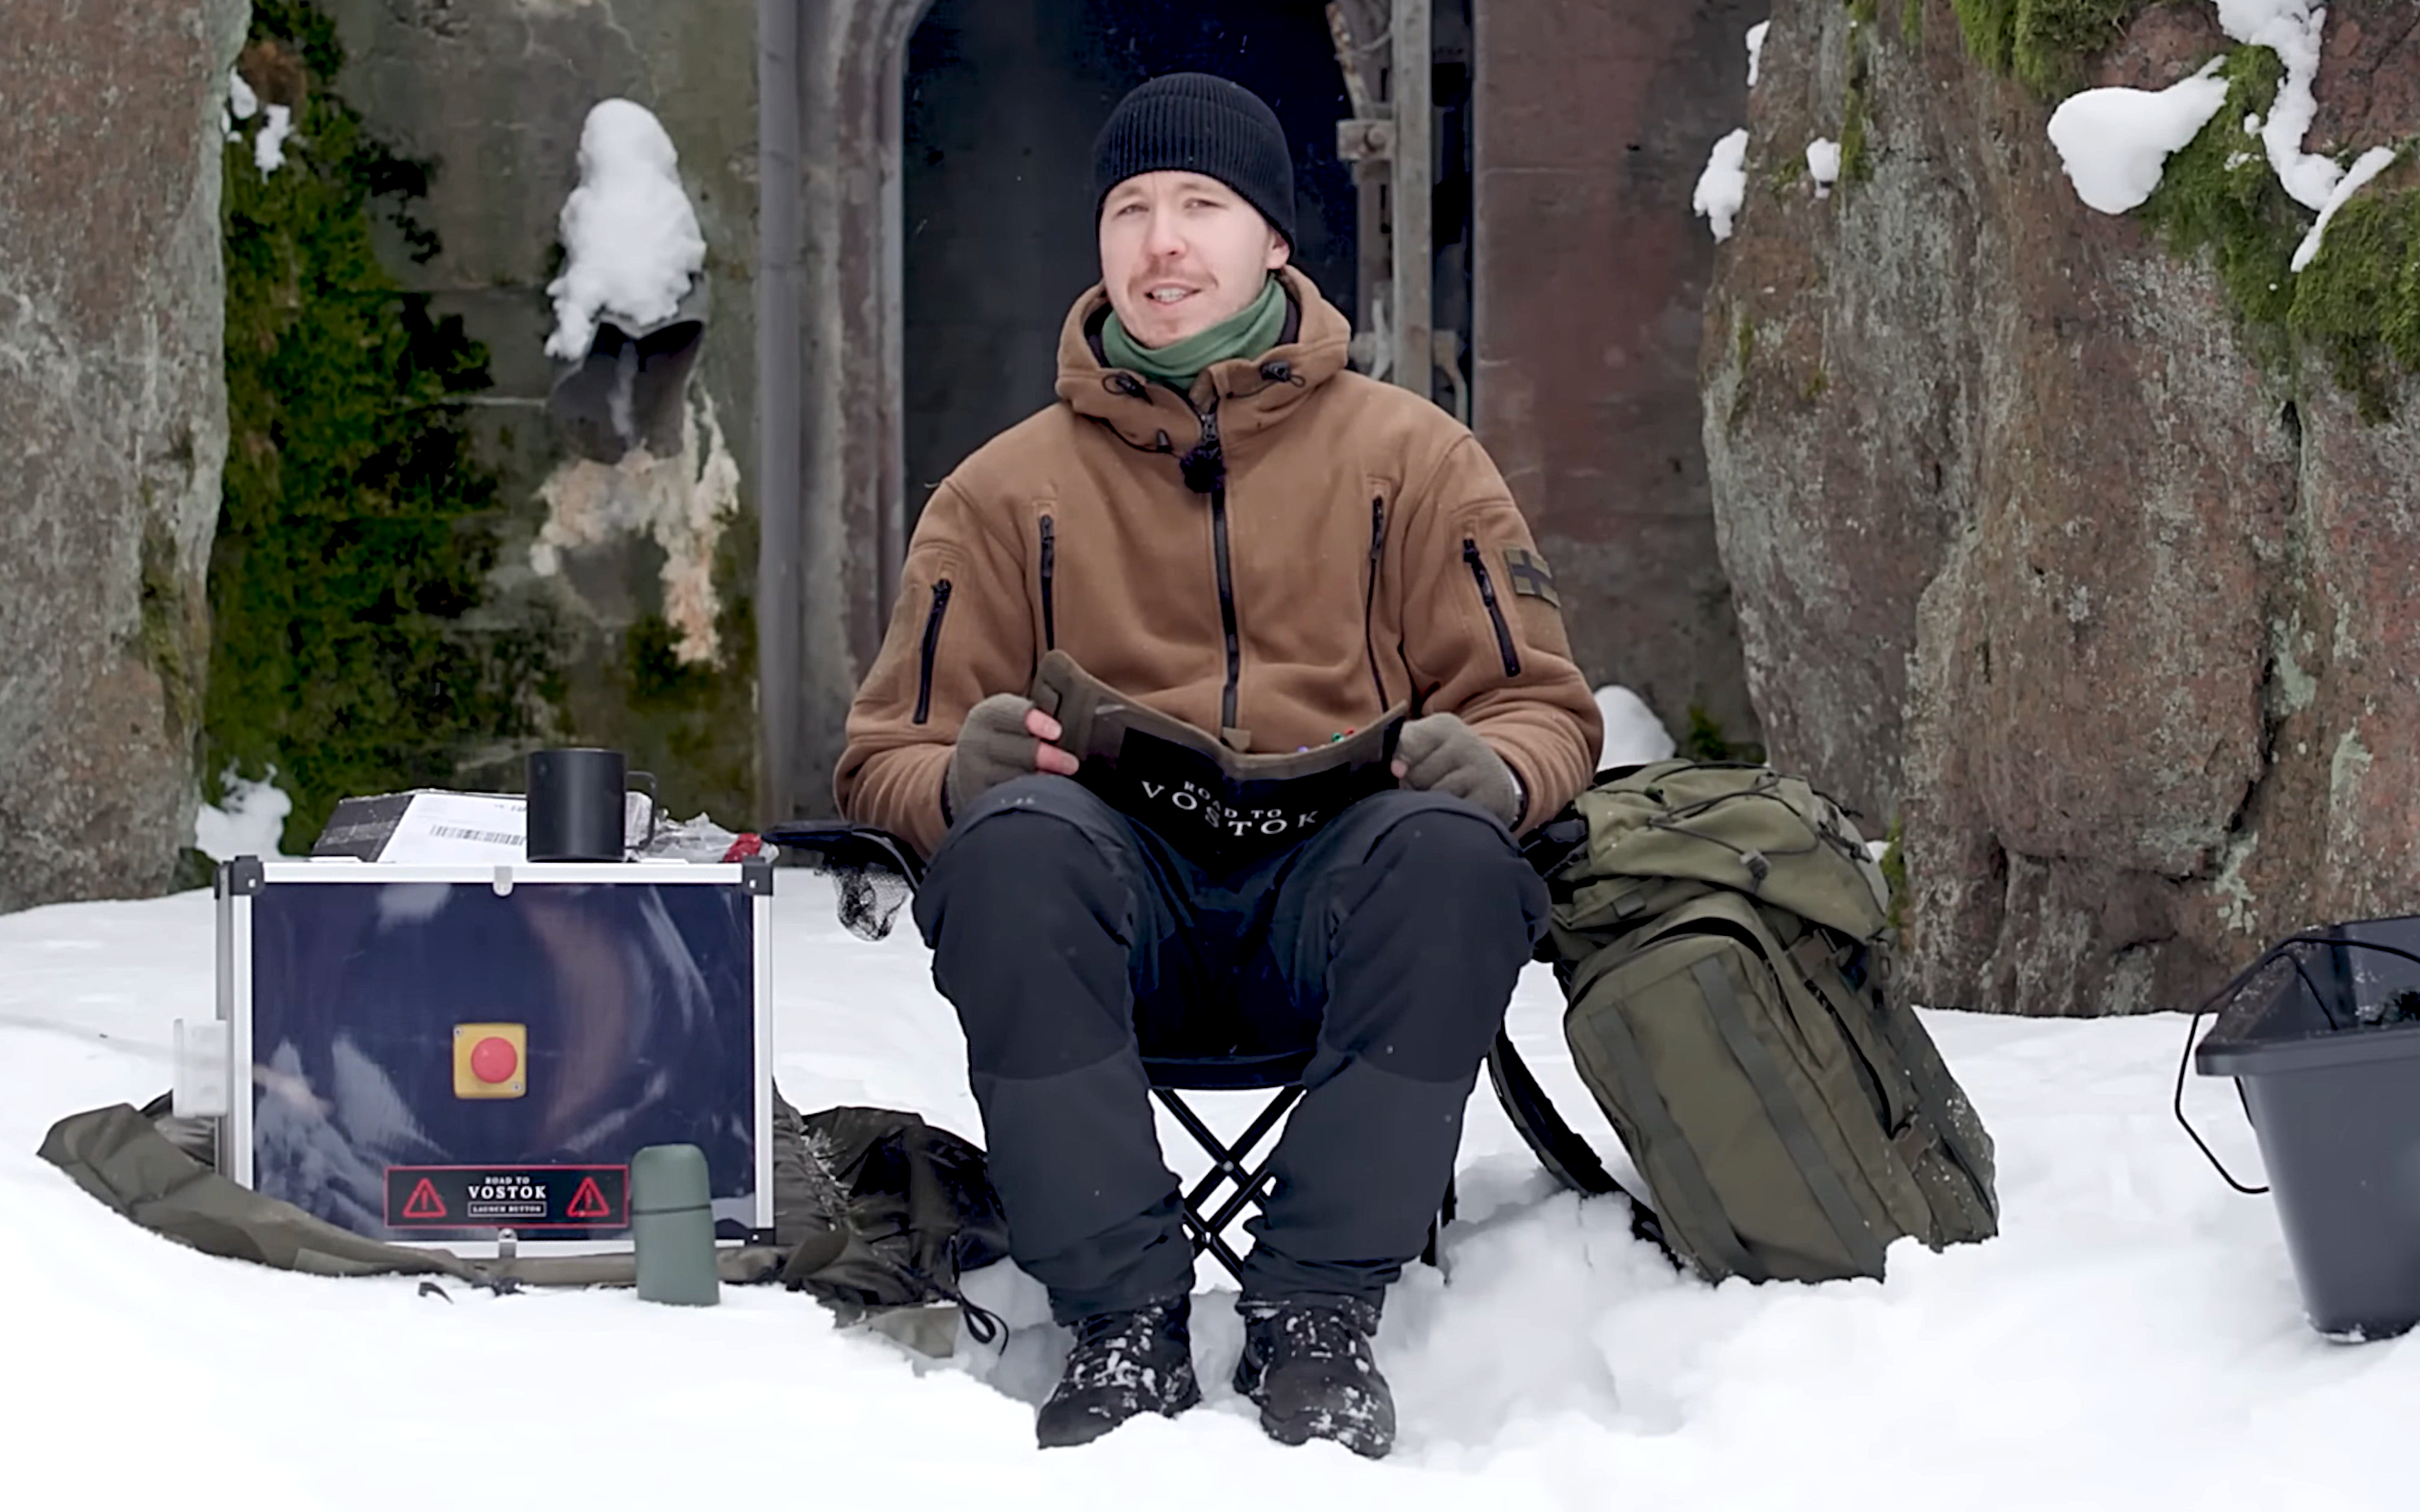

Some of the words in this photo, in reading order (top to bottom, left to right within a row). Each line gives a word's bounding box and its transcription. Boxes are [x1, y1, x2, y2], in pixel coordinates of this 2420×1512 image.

[1141, 780, 1319, 837] VOSTOK
[1184, 780, 1238, 819] ROAD
[1250, 808, 1282, 819] TO
[468, 1185, 546, 1200] VOSTOK
[485, 1176, 513, 1185] ROAD
[515, 1176, 530, 1185] TO
